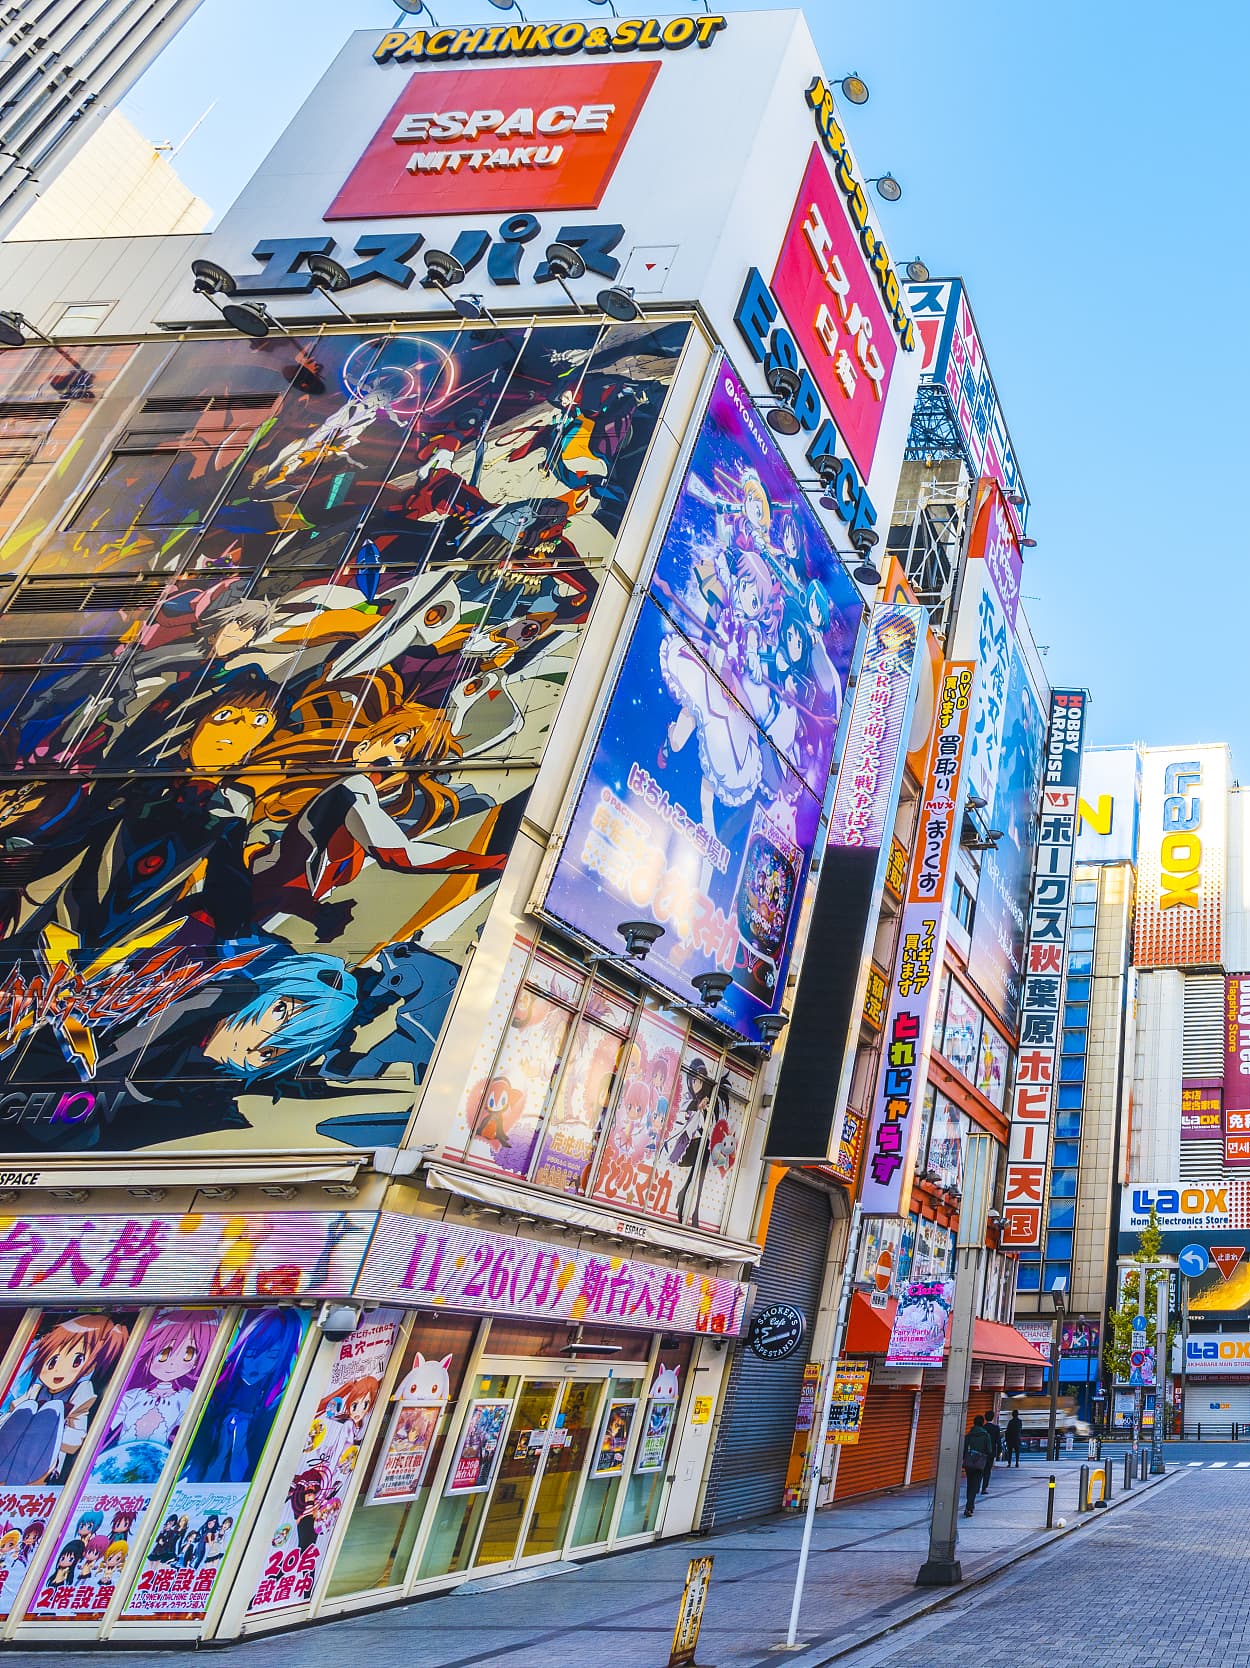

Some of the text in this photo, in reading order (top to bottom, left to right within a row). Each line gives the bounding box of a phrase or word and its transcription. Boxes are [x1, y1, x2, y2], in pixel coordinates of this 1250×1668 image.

[374, 15, 726, 64] PACHINKO&SLOT
[392, 103, 617, 143] ESPACE
[405, 144, 564, 176] NITTAKU
[228, 214, 625, 294] エスパス
[801, 203, 885, 401] エスパス
[731, 393, 768, 455] KYORAKU
[733, 267, 878, 550] ESPACE
[956, 671, 972, 710] DVD
[1047, 695, 1067, 782] PARADISE
[1065, 695, 1083, 753] HOBBY
[1227, 980, 1239, 1053] Flagship Store
[870, 1011, 921, 1187] とれじゃらす
[624, 1223, 647, 1238] ESPACE
[1156, 1216, 1202, 1226] Electronics
[1205, 1215, 1229, 1225] Store
[757, 1305, 798, 1326] SMOKER'S
[267, 1545, 321, 1576] 20台
[37, 1586, 116, 1610] 2階設置
[137, 1569, 216, 1593] 2階設置
[254, 1578, 313, 1605] 設置中
